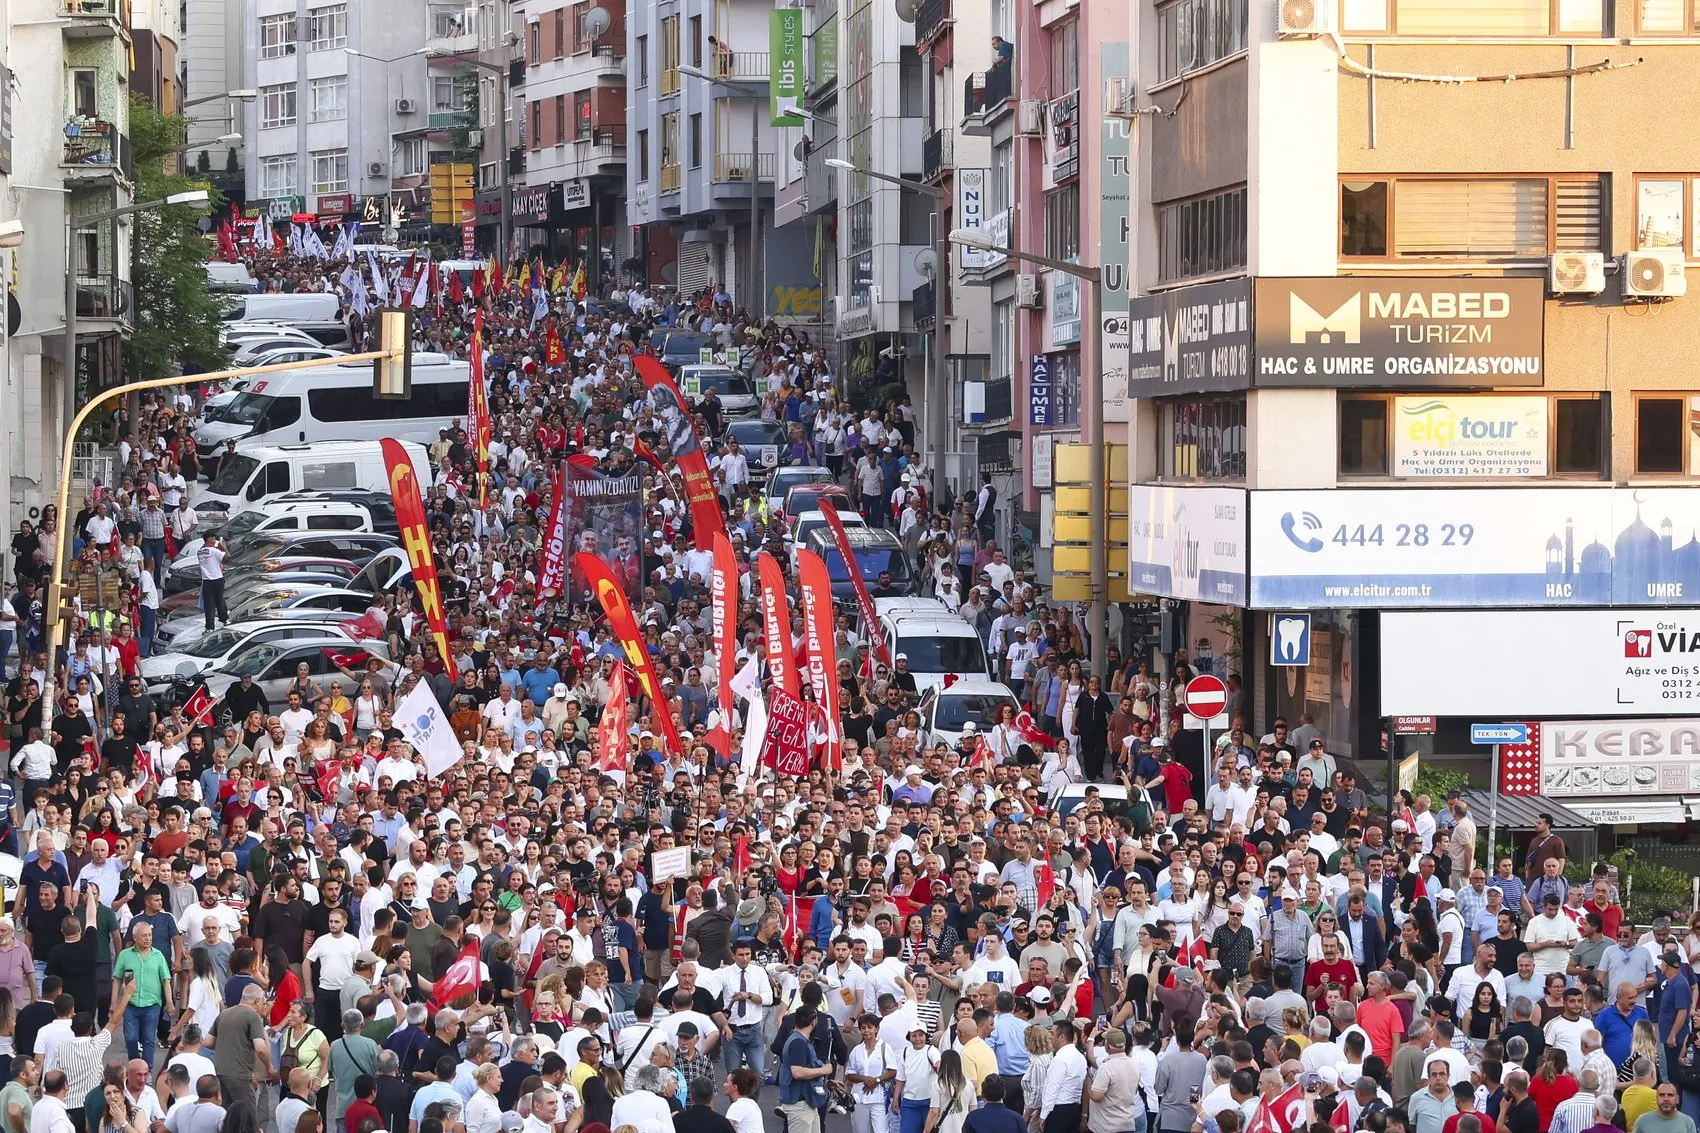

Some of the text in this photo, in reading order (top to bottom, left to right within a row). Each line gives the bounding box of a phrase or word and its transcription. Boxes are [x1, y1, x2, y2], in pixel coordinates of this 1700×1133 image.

[779, 60, 794, 88] ibis
[512, 196, 528, 216] AKAY
[528, 190, 548, 216] ÇİÇEK
[1368, 292, 1510, 319] MABED
[1179, 304, 1209, 344] MABED
[1034, 355, 1047, 382] HAC
[1261, 353, 1540, 374] HAC & UMRE ORGANİZASYONU
[1032, 388, 1048, 423] UMRE
[1409, 413, 1518, 448] elçi tour
[1332, 523, 1474, 546] 444 28 29
[1325, 584, 1432, 597] www.elcitur.com.tr
[1546, 583, 1572, 598] HAC
[1647, 583, 1682, 597] UMRE
[1625, 666, 1650, 677] Ağız
[1672, 666, 1689, 677] Diş
[1554, 728, 1700, 758] KEBA
